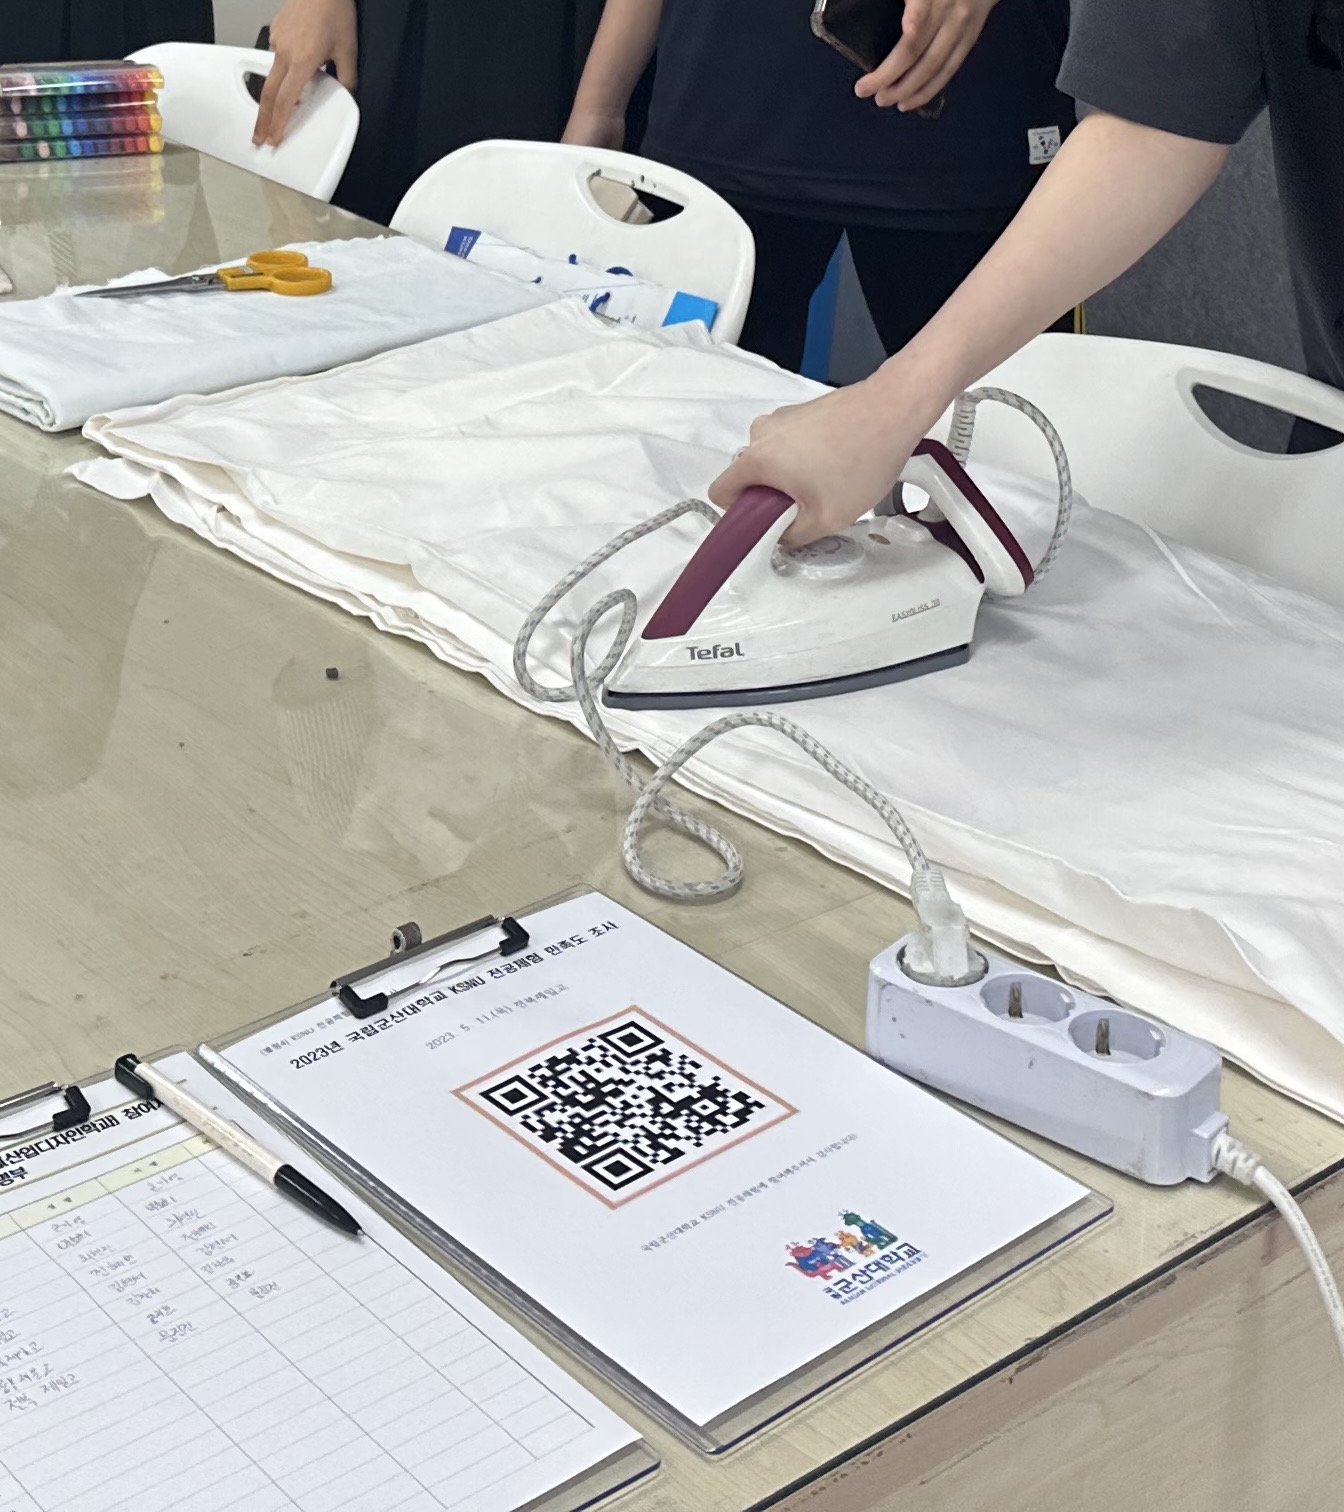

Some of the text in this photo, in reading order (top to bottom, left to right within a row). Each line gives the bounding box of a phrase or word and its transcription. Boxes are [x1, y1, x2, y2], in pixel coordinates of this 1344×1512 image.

[685, 641, 745, 661] Tefal
[290, 921, 618, 1069] 2023년 국립군산대학교 KSNU 전공체험 만족도 조사
[833, 1243, 921, 1294] 군산대학교
